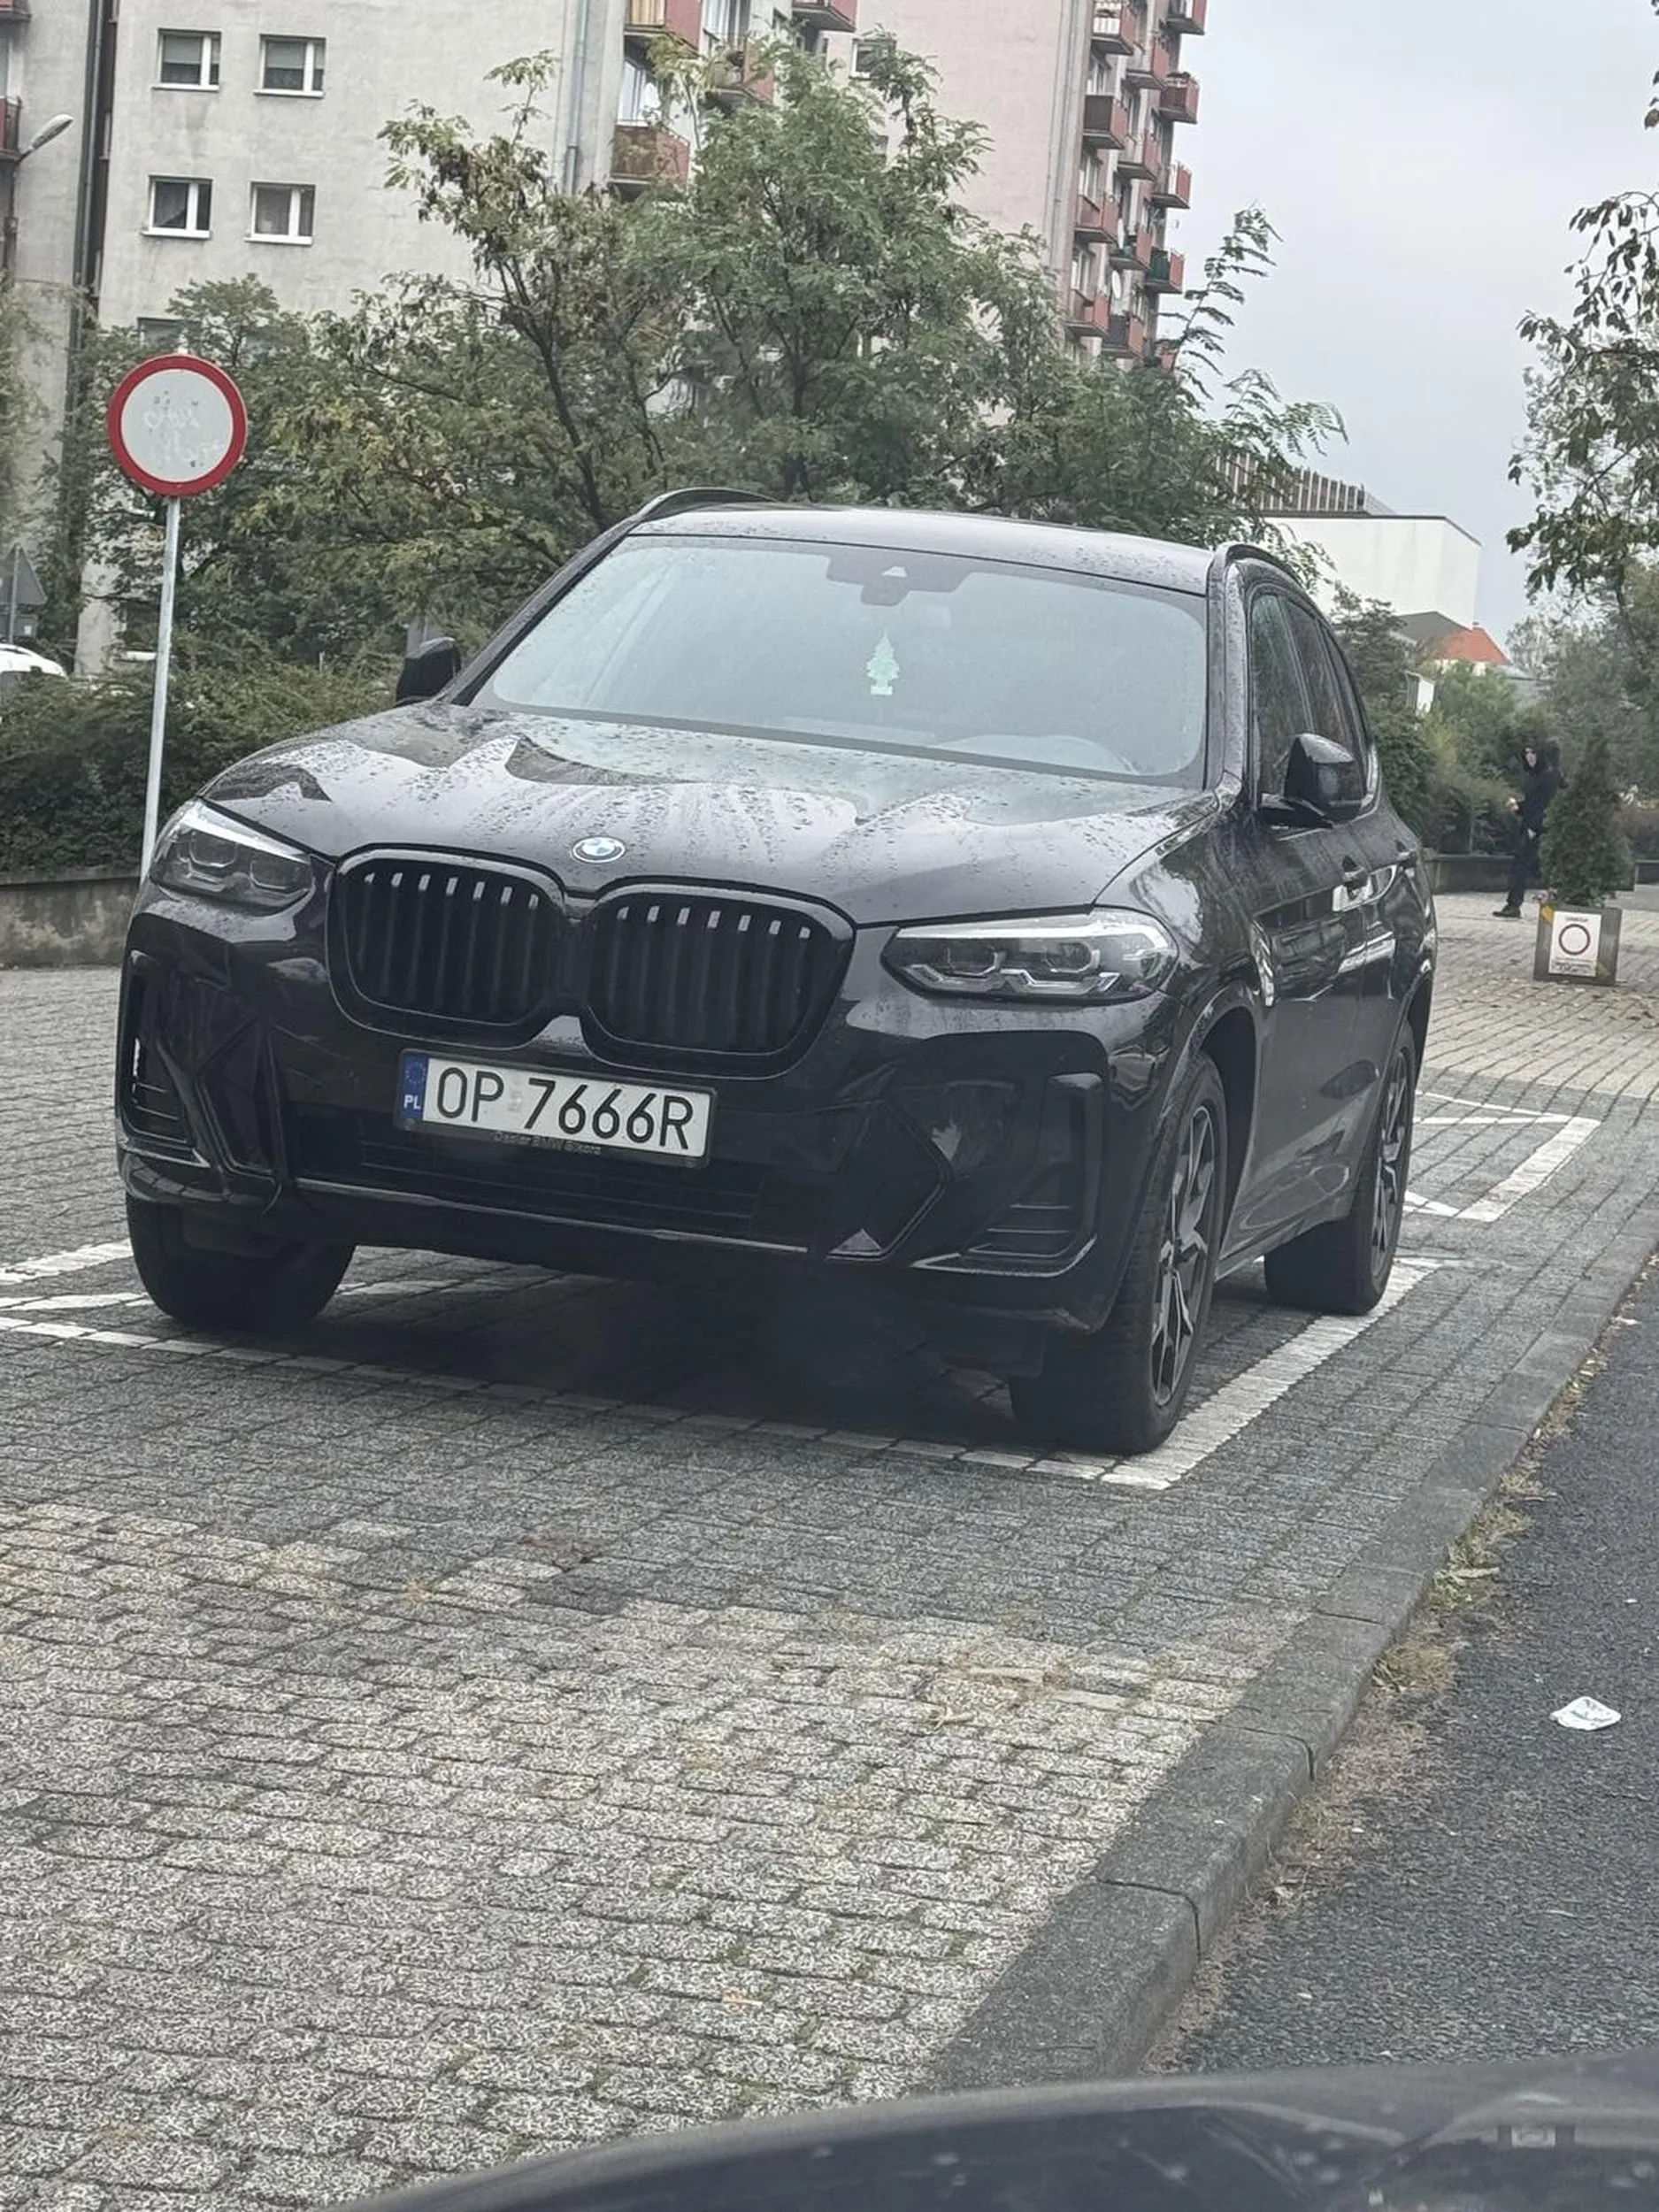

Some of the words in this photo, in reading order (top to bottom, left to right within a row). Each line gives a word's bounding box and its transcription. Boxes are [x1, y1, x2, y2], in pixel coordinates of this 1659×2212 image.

[403, 1094, 421, 1110] PL
[436, 1066, 504, 1122] OP
[524, 1077, 694, 1150] 7666R
